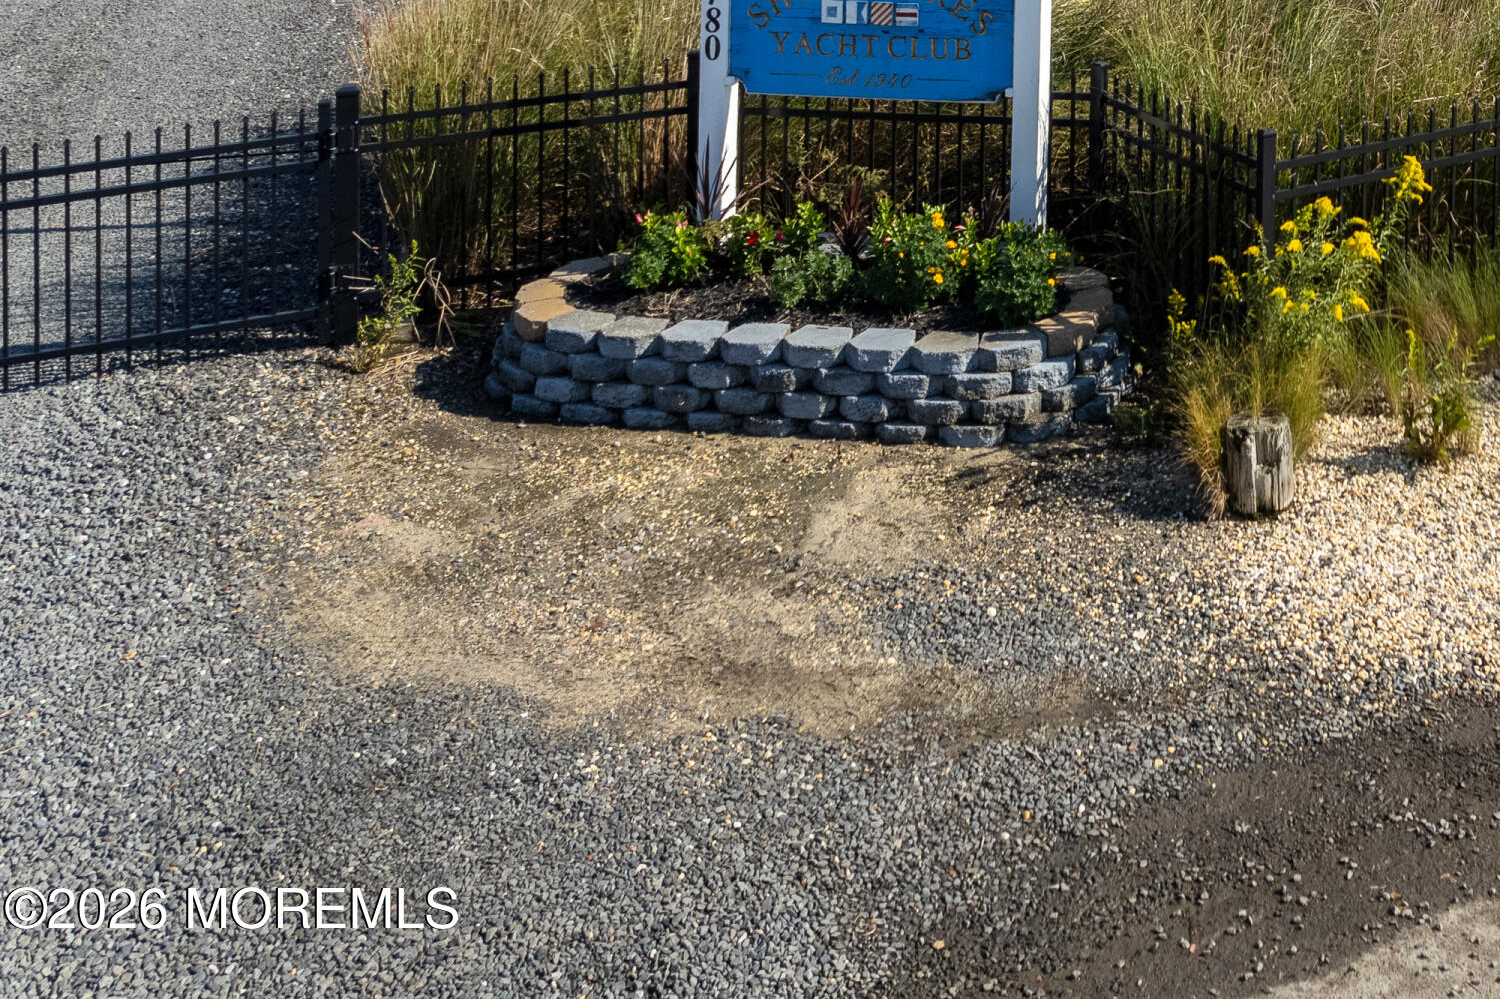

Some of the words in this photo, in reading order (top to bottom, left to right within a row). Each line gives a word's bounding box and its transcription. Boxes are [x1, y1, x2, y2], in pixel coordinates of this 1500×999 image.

[768, 31, 879, 58] YACHT
[887, 35, 972, 61] CLUB
[864, 71, 914, 89] 1940
